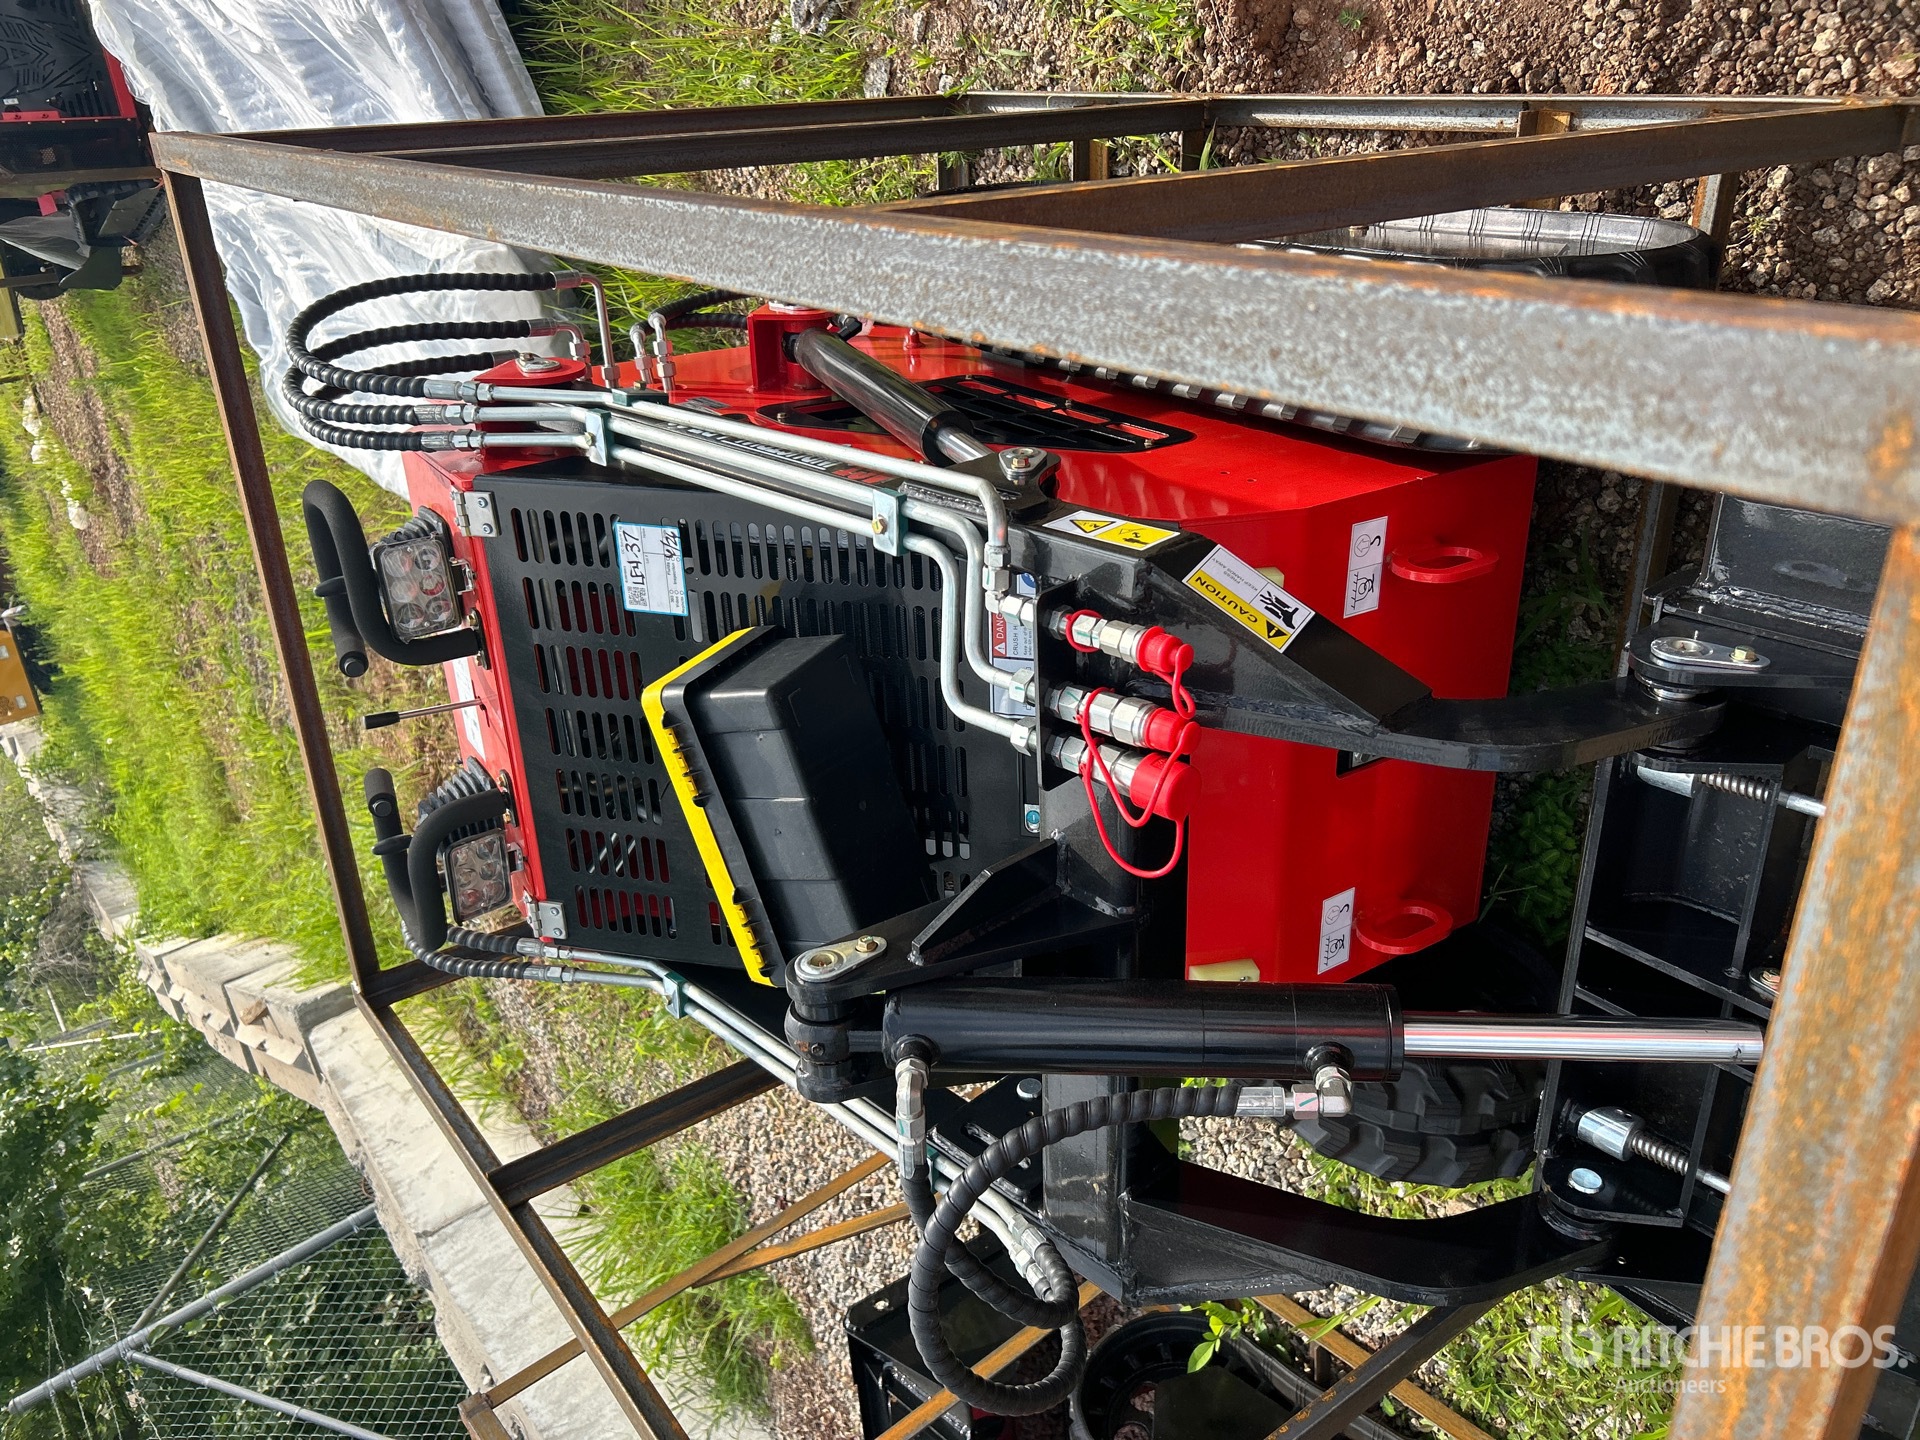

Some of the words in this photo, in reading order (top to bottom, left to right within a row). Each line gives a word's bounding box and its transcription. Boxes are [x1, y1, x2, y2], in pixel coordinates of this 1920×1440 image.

[1212, 557, 1227, 569] AWAY
[1223, 571, 1240, 585] PRESS
[1226, 568, 1245, 582] HANDS
[1244, 580, 1258, 592] KEEP
[1195, 576, 1258, 623] CAUTION
[996, 613, 1004, 639] DANG
